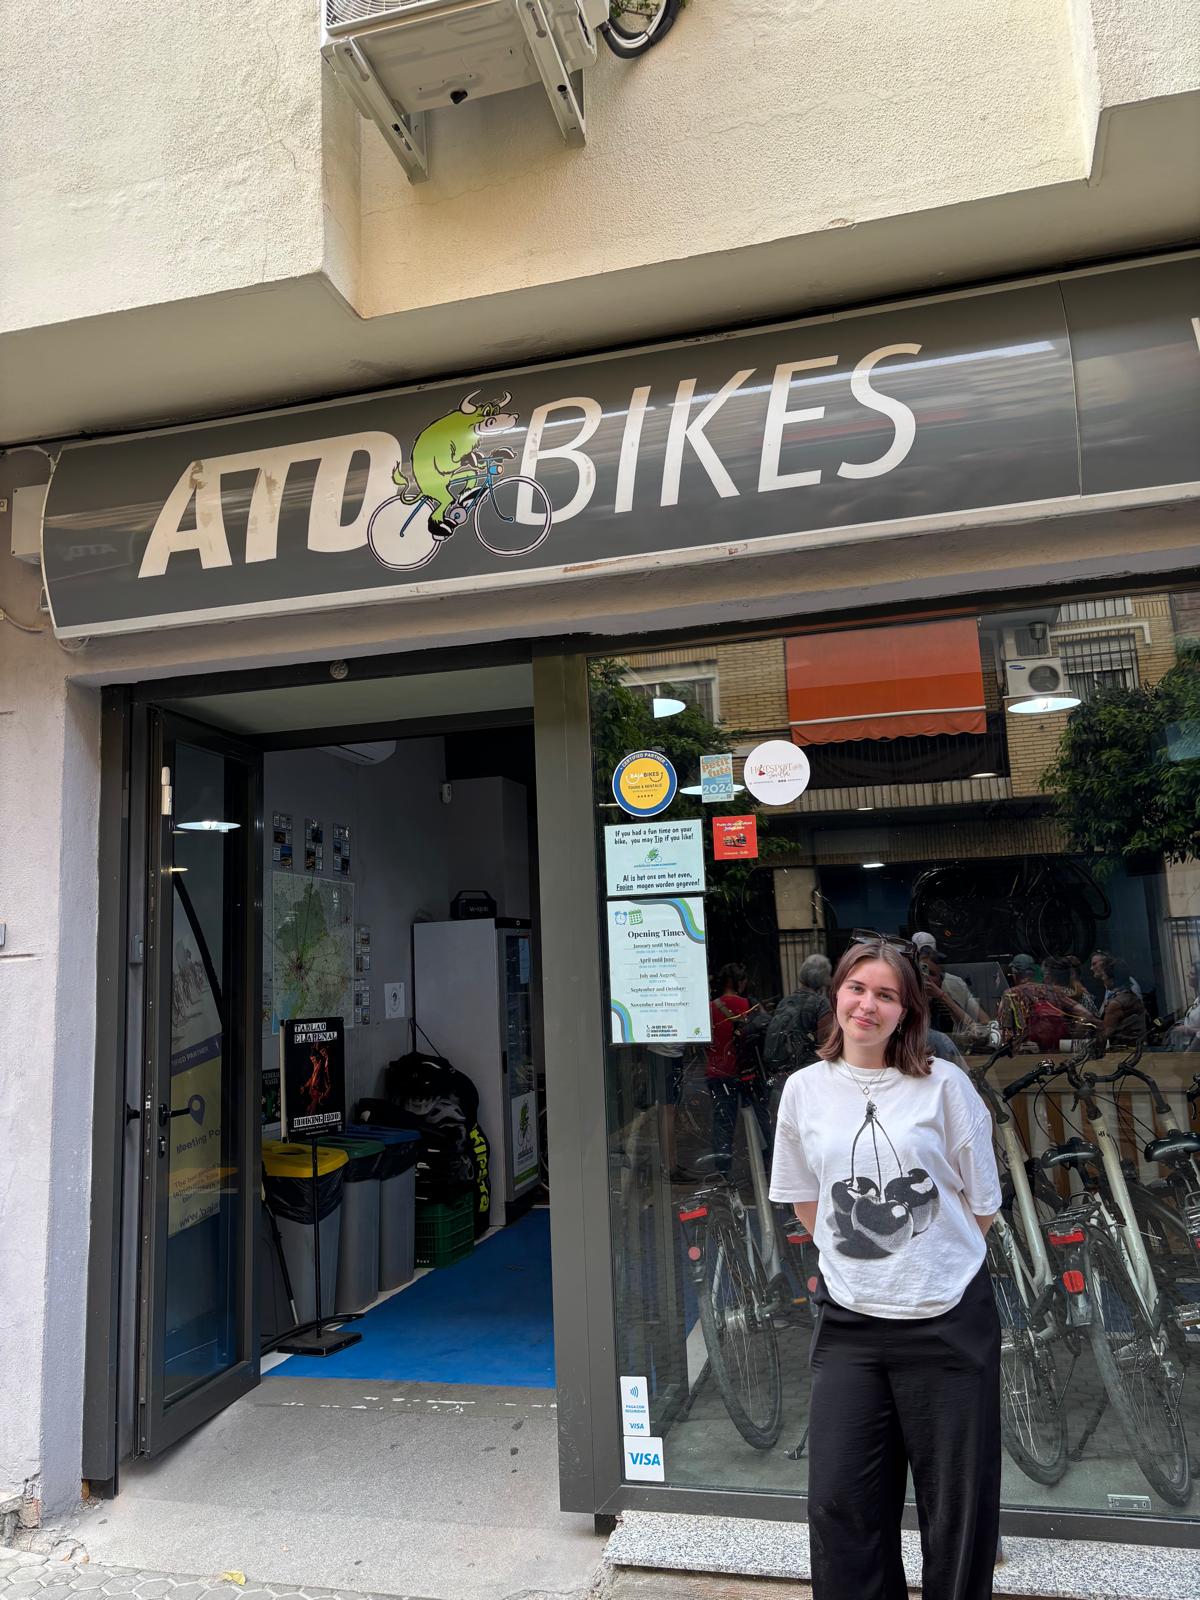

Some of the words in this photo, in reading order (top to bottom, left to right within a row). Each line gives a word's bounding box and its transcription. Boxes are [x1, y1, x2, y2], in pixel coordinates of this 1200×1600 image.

[138, 430, 401, 578] ATO
[515, 343, 922, 526] BIKES
[622, 753, 644, 767] CERTIFIED
[644, 753, 666, 764] PARTNER
[703, 784, 731, 794] 2024
[680, 827, 692, 835] your
[631, 838, 640, 846] you
[642, 837, 653, 845] may
[654, 836, 663, 844] Tip
[623, 874, 629, 882] Al
[676, 878, 700, 890] gegeven!
[628, 930, 660, 940] Opening
[662, 929, 686, 937] Times
[295, 1022, 326, 1032] TABLAO
[295, 1034, 306, 1044] EL
[306, 1032, 337, 1042] ARENAL
[176, 1135, 207, 1153] Meeting
[628, 1422, 644, 1430] VISA
[628, 1452, 661, 1466] VISA
